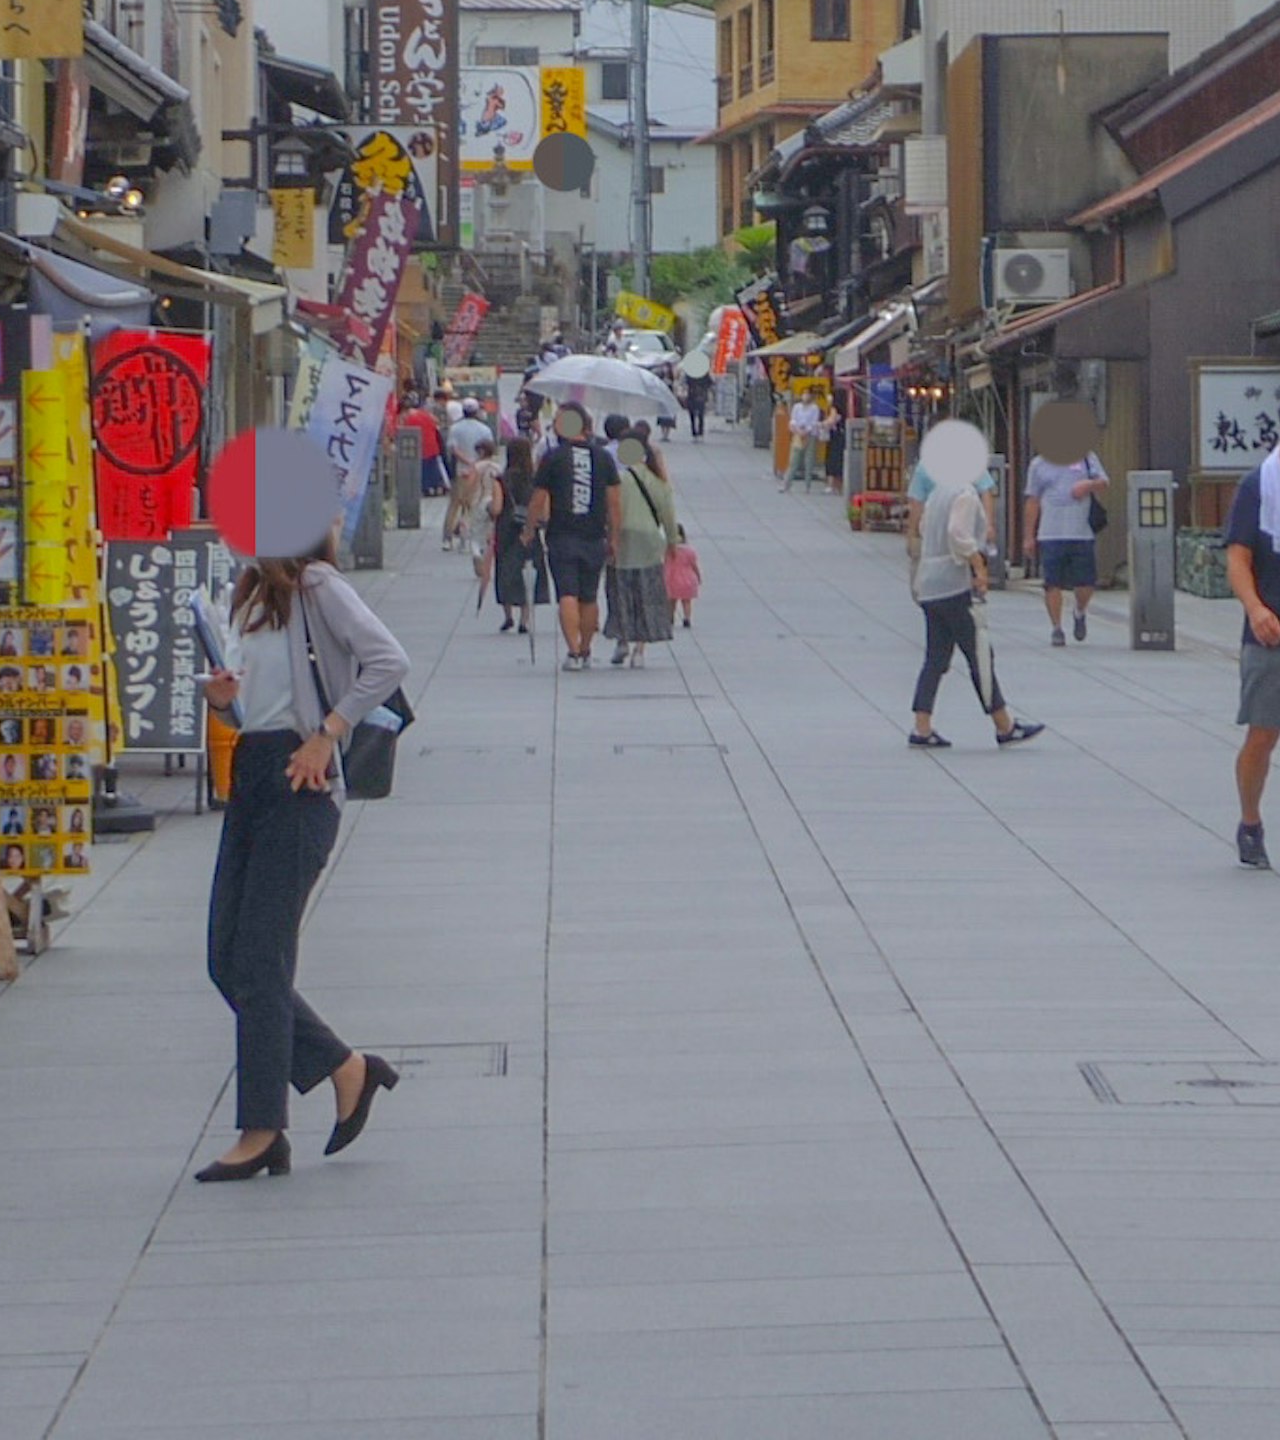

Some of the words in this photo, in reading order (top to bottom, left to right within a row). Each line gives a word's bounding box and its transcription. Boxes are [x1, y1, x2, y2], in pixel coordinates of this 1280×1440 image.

[378, 6, 400, 73] Udon
[125, 553, 160, 740] しょうゆソフト
